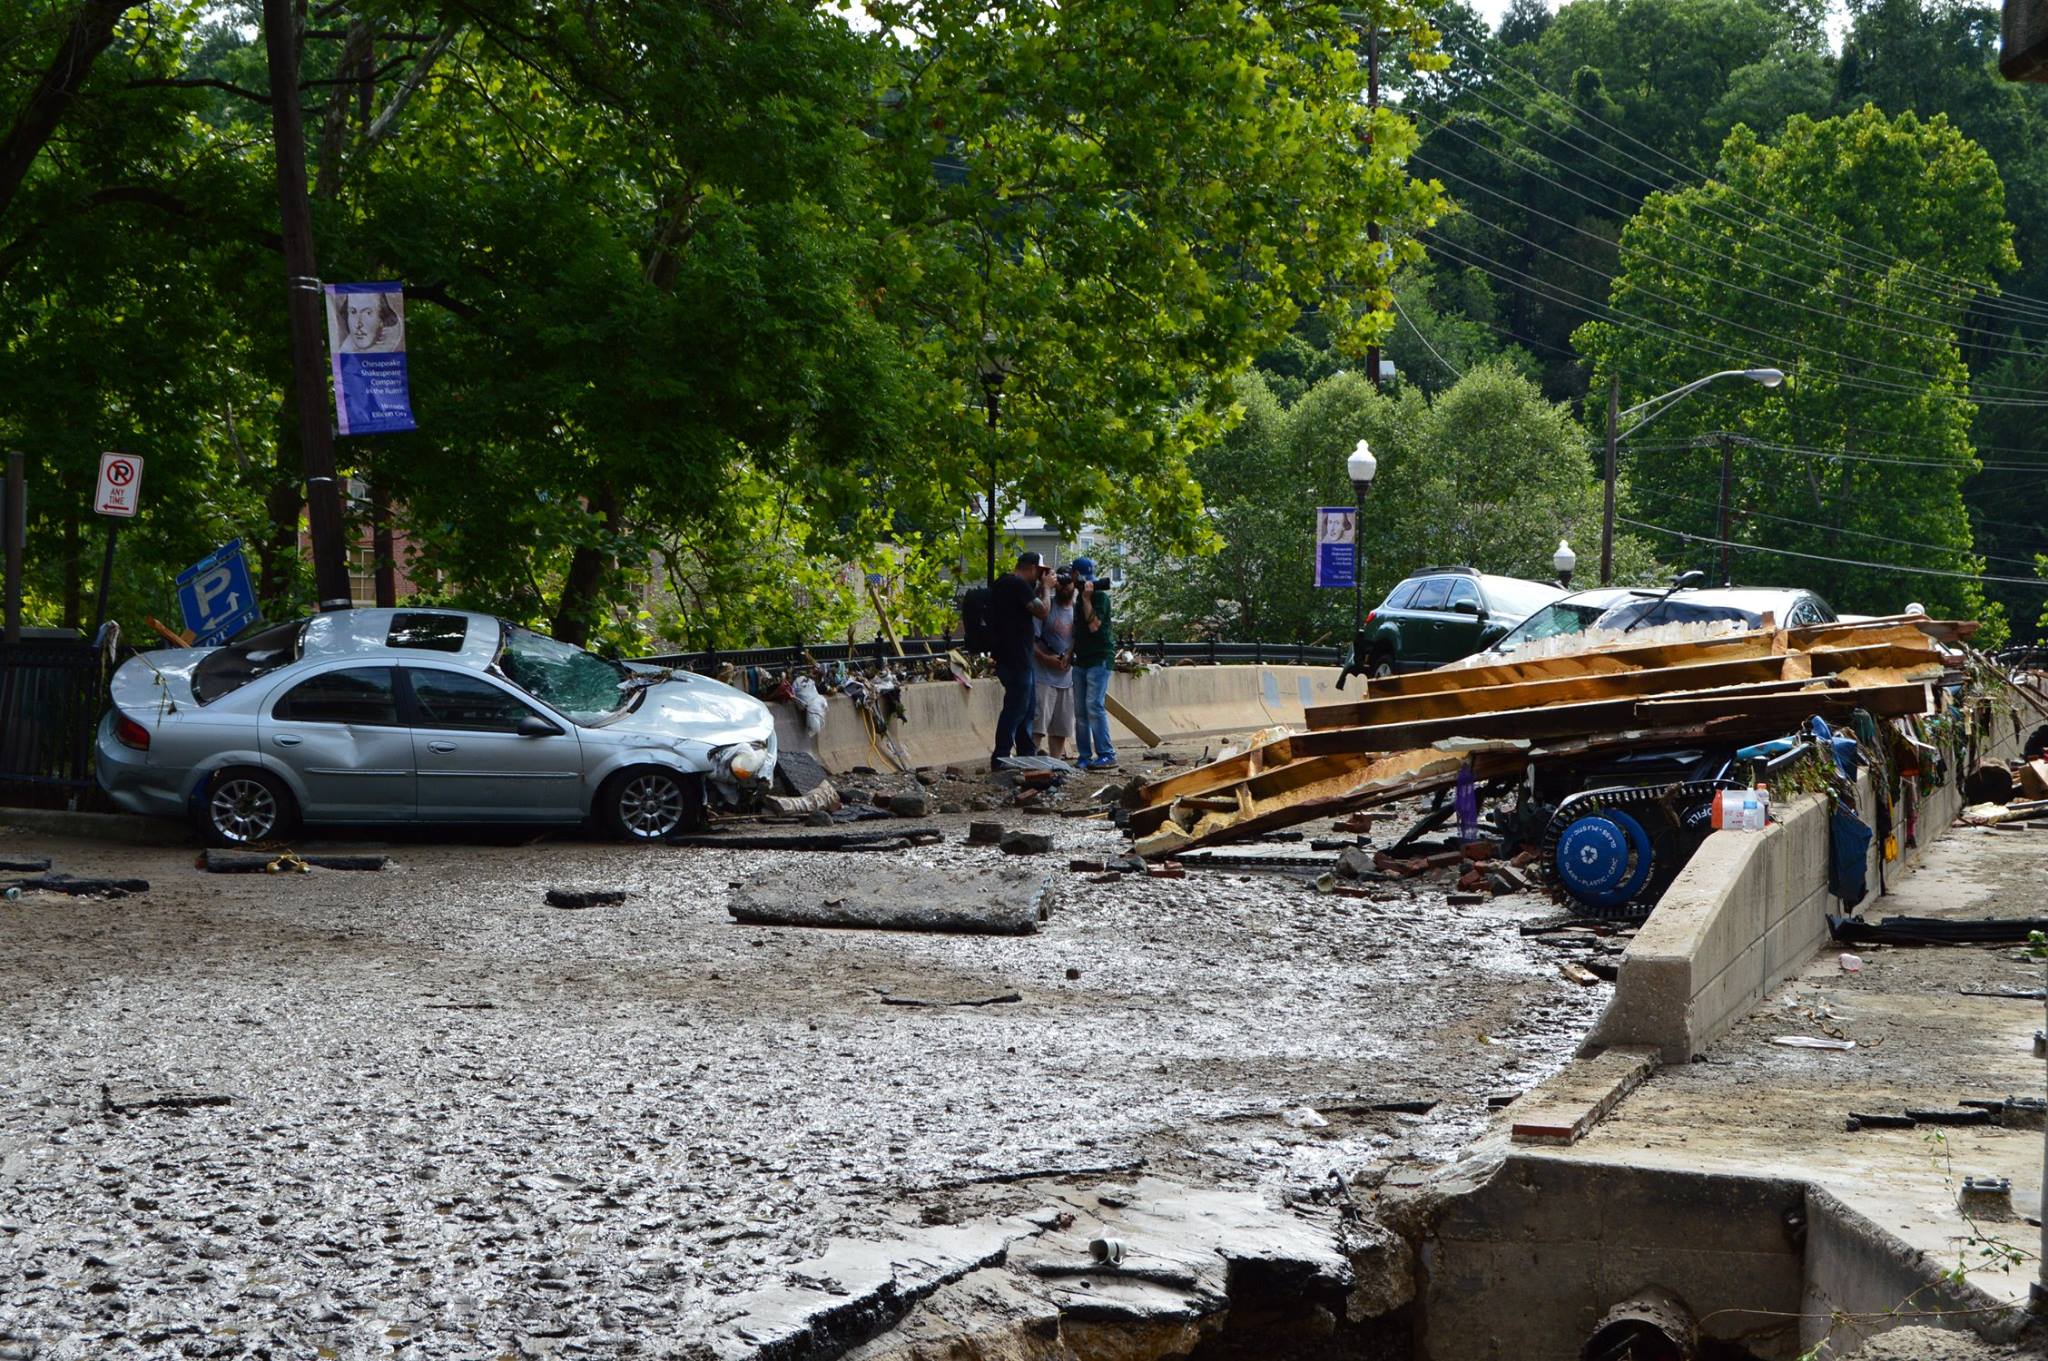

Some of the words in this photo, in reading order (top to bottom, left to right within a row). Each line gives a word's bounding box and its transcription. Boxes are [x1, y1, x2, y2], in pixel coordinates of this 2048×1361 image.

[110, 496, 126, 505] TIME
[193, 568, 231, 618] P
[1687, 807, 1712, 827] DFILL
[1574, 824, 1599, 836] PLASTIC
[1602, 829, 1617, 848] GLASS
[1582, 876, 1608, 887] PLASTIC
